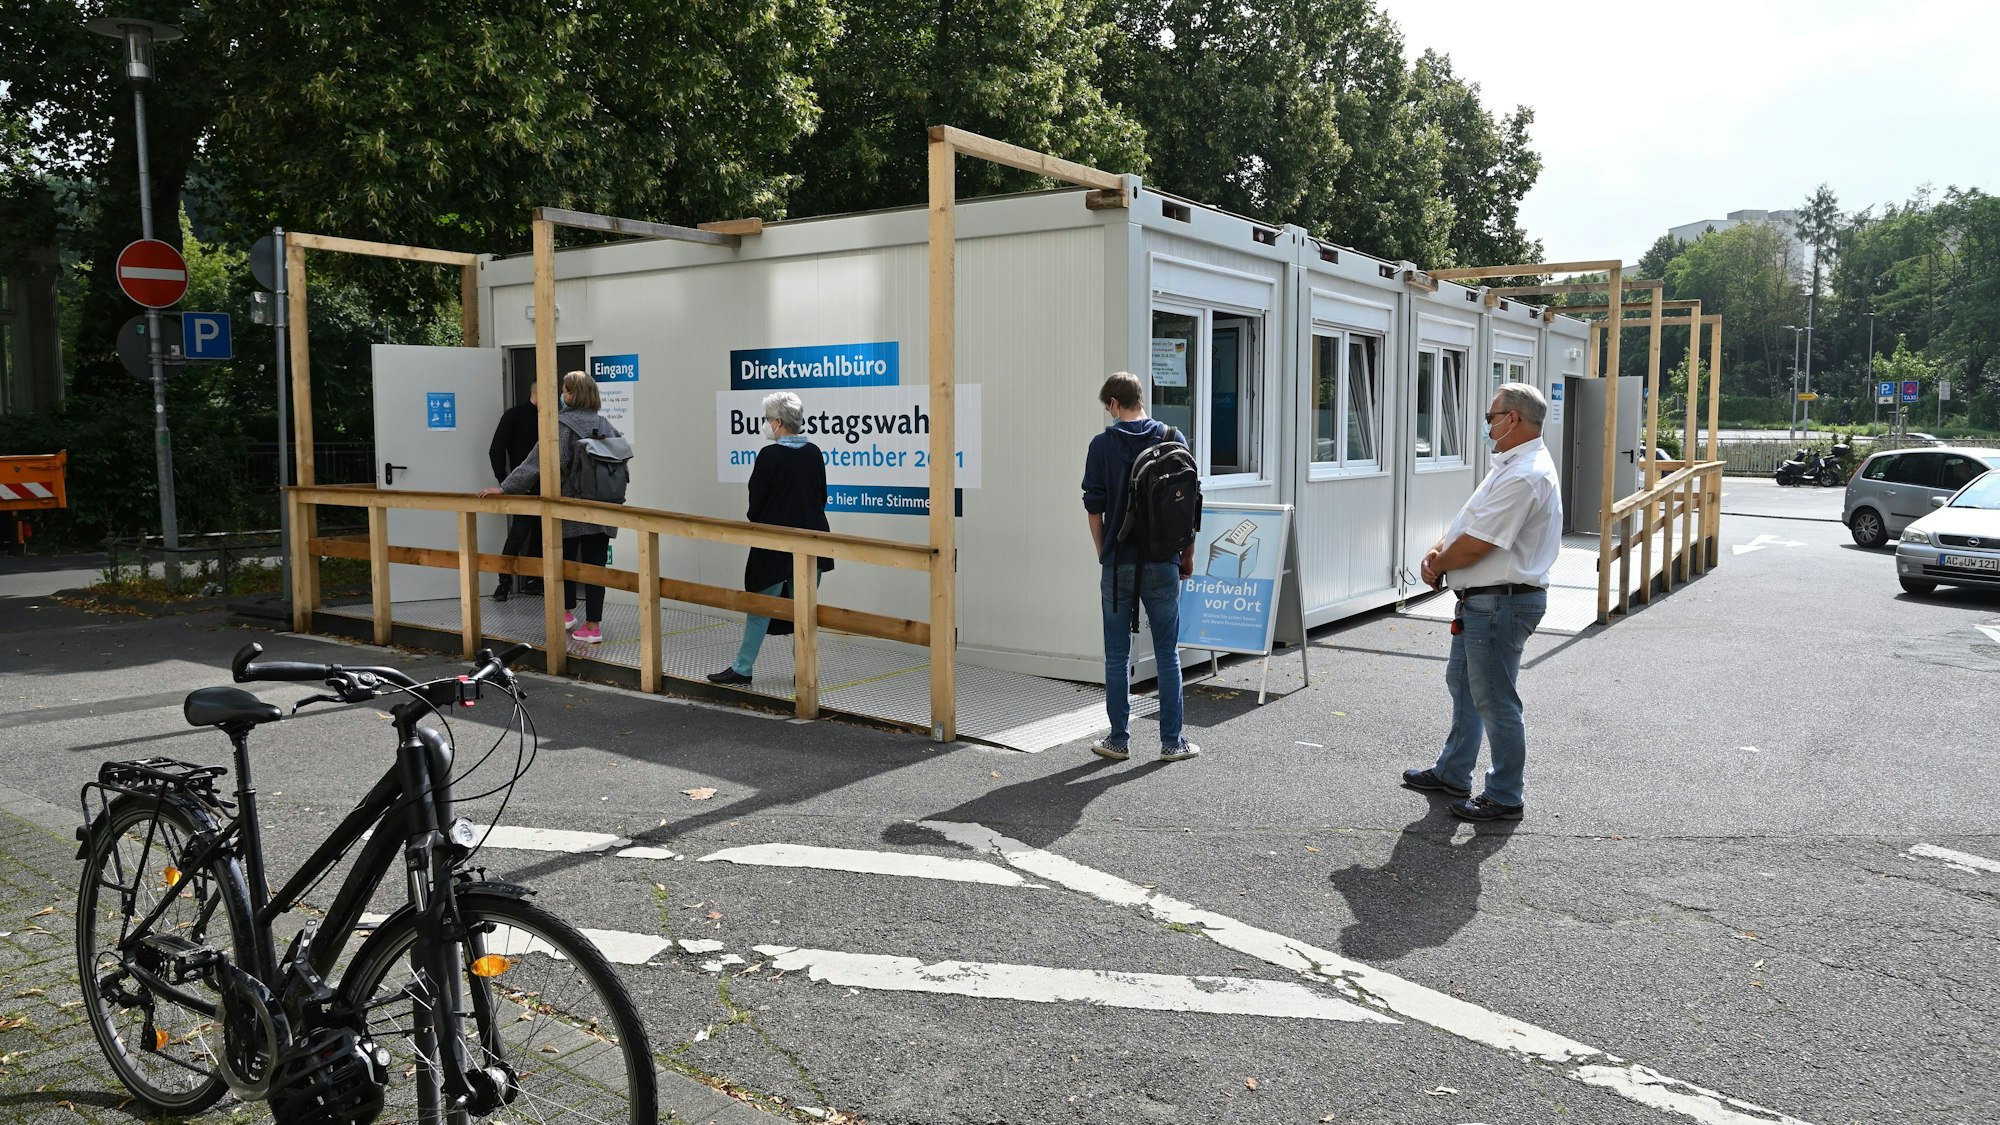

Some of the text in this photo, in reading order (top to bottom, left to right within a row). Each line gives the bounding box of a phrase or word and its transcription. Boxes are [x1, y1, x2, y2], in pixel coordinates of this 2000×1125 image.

[194, 318, 220, 353] P
[595, 362, 634, 379] Eingang
[741, 356, 887, 380] Direktwahlbüro
[1881, 383, 1890, 395] P
[731, 404, 929, 444] Bustagswah
[731, 444, 964, 468] am tember 21
[836, 492, 858, 506] hier
[861, 493, 884, 507] Ihre
[886, 494, 930, 509] Stimme
[1946, 556, 1996, 569] AC UW 121
[1185, 579, 1257, 596] Briefwahl
[1204, 597, 1262, 613] vor Ort
